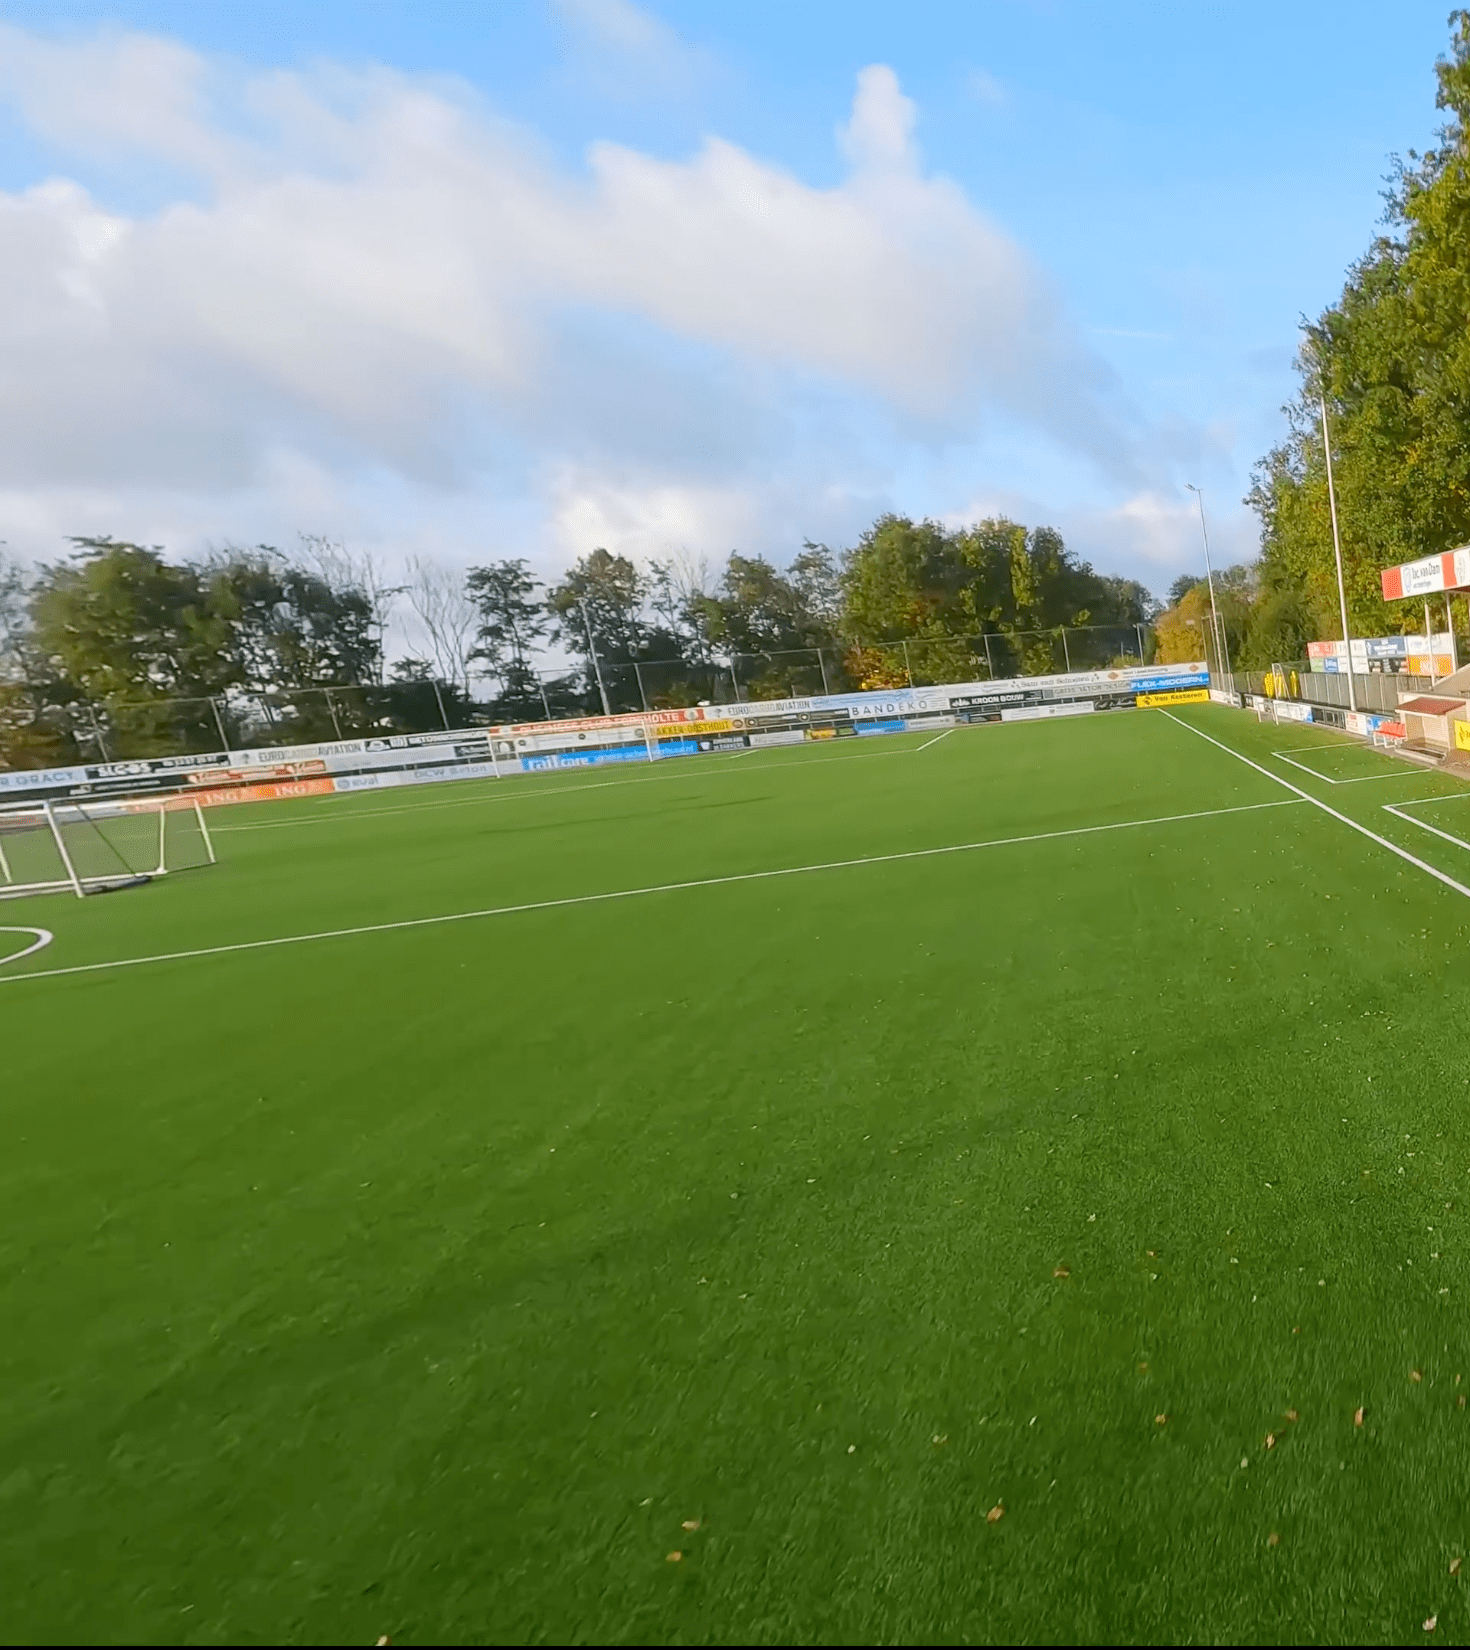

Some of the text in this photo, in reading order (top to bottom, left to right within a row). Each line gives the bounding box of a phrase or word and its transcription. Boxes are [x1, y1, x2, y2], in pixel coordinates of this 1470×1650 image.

[971, 693, 1025, 705] KROON BOUW
[851, 700, 928, 716] BANDEKO
[205, 791, 238, 804] ING
[275, 784, 307, 798] ING
